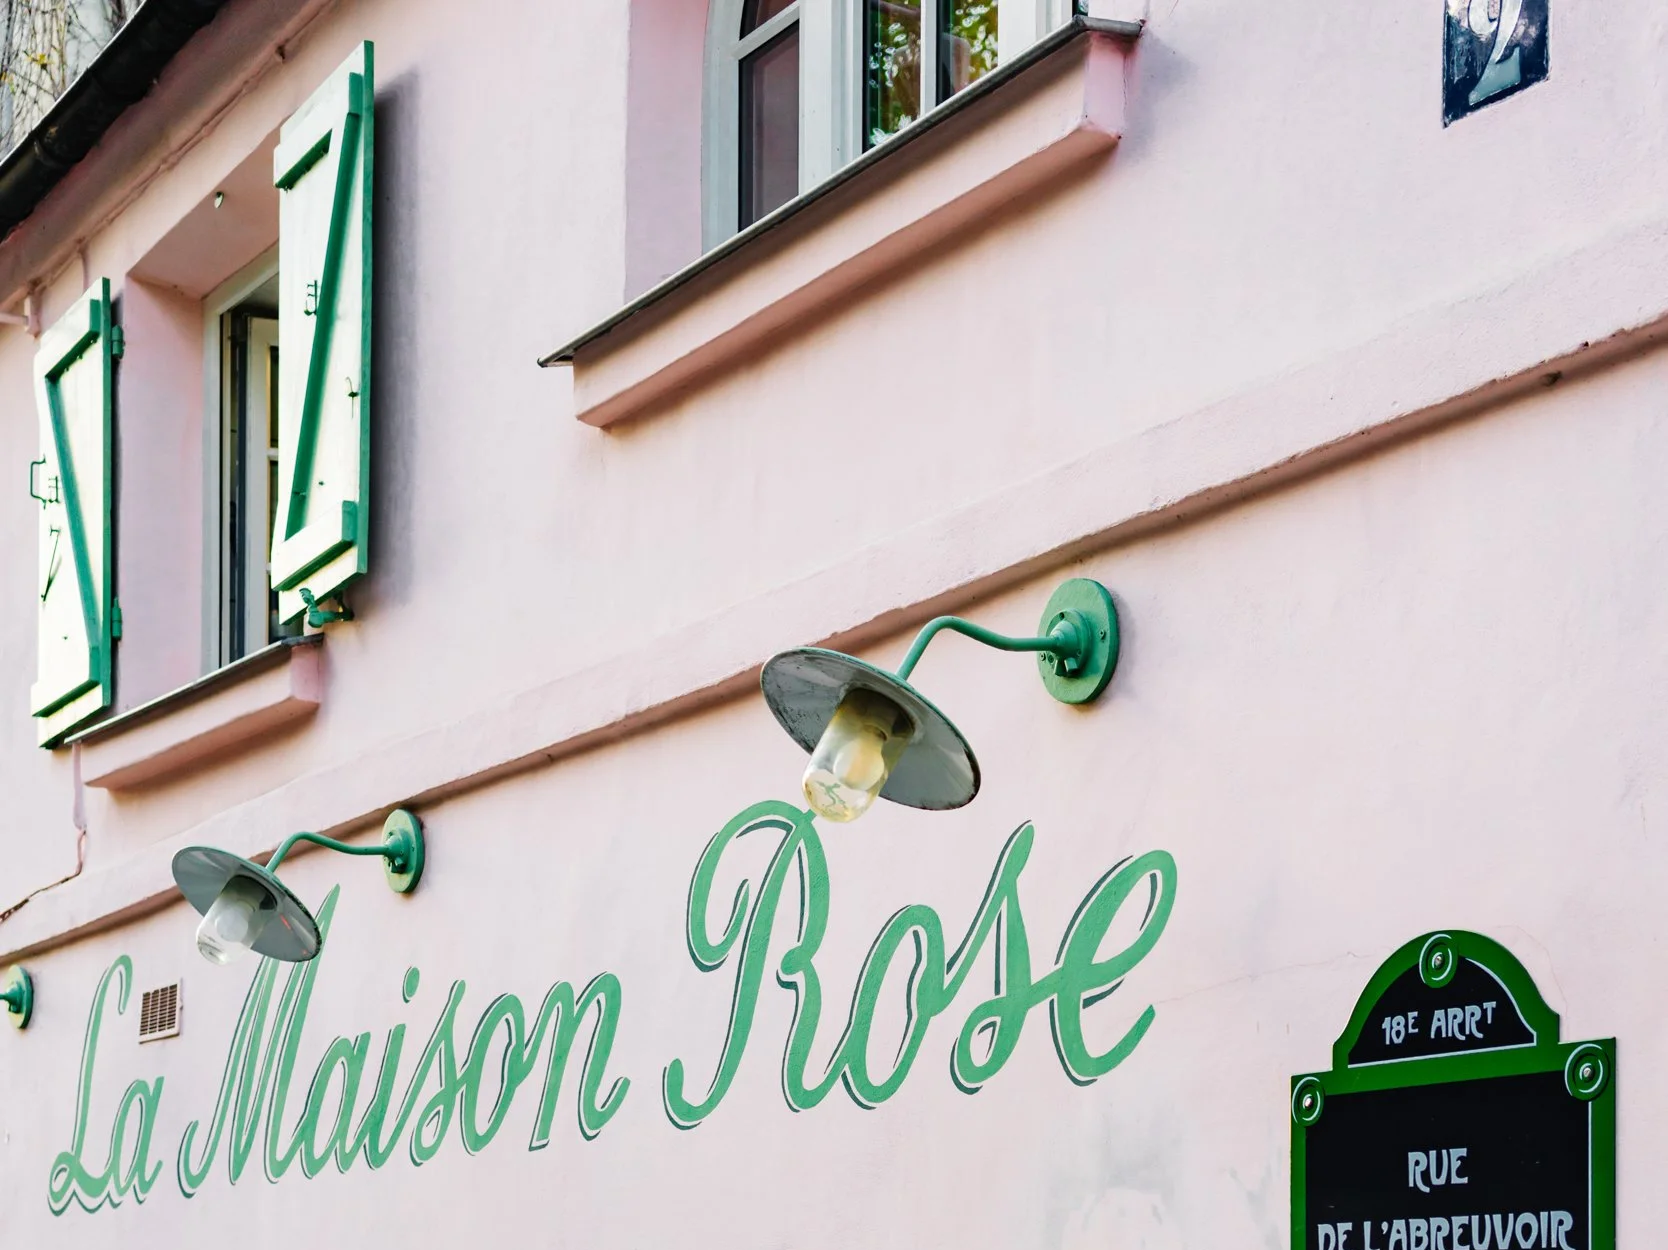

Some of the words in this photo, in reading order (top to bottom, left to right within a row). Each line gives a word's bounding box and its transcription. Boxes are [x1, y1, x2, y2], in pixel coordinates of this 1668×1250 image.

[47, 954, 165, 1217] La
[177, 883, 631, 1199] Maison
[662, 799, 1178, 1131] Rose
[1382, 1010, 1420, 1046] 18E
[1430, 1001, 1497, 1041] ARRT
[1407, 1147, 1469, 1194] RUE
